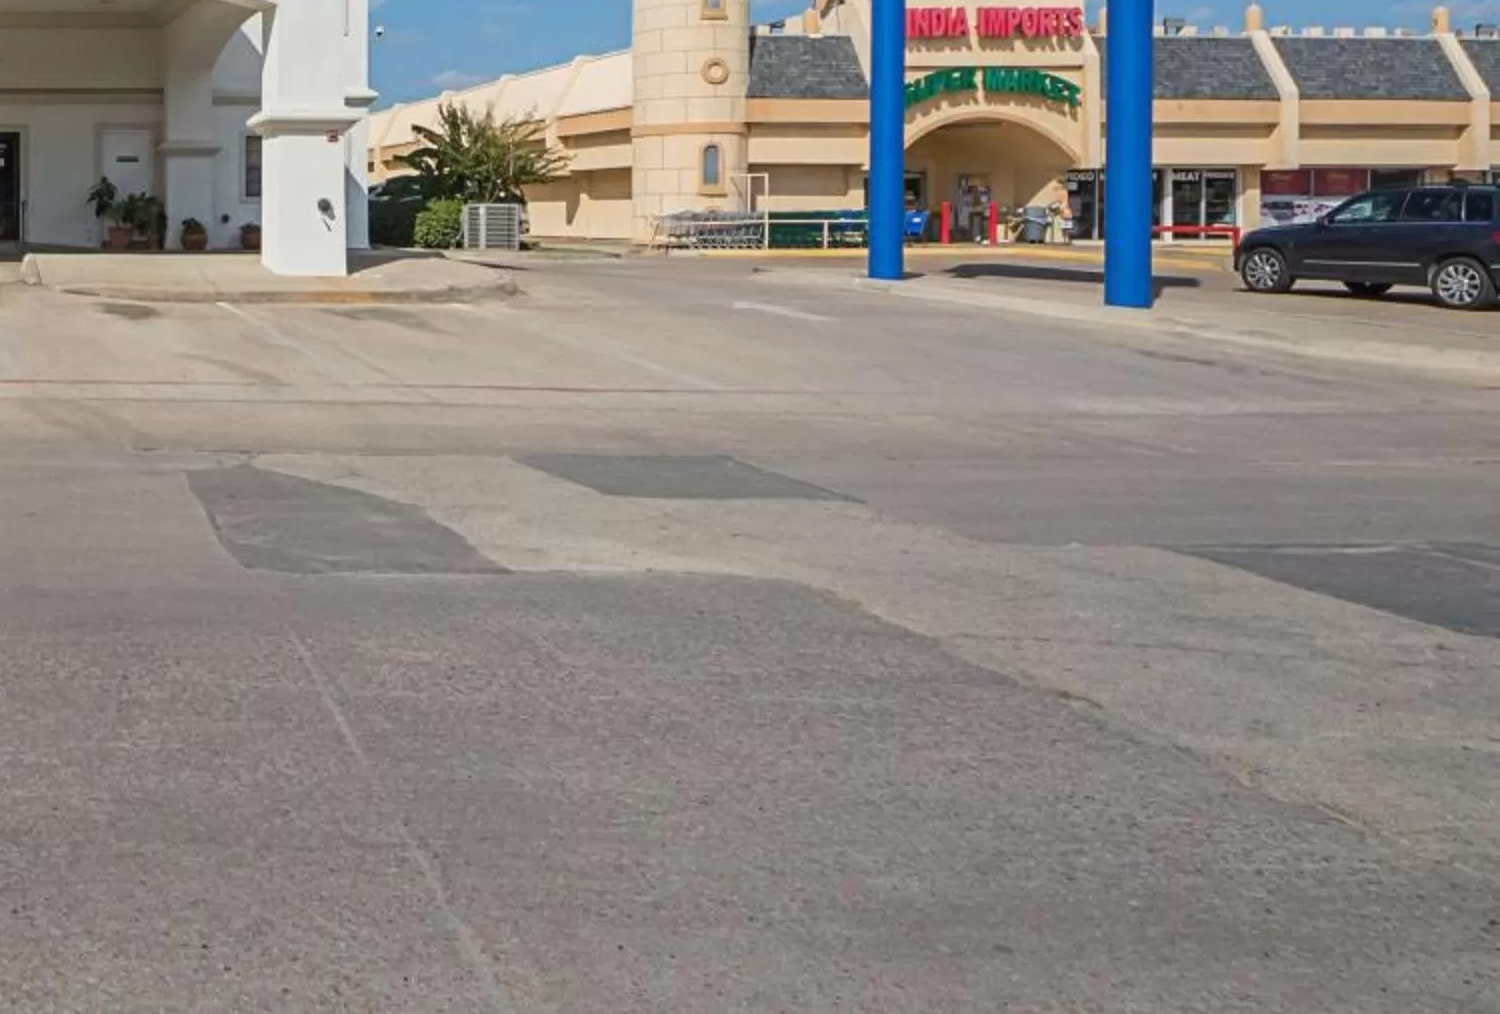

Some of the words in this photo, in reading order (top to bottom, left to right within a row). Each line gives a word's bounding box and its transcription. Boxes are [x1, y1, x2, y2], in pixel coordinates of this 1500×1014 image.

[906, 6, 968, 40] INDIA
[976, 6, 1082, 39] IMPORTS
[984, 65, 1081, 107] MARKET
